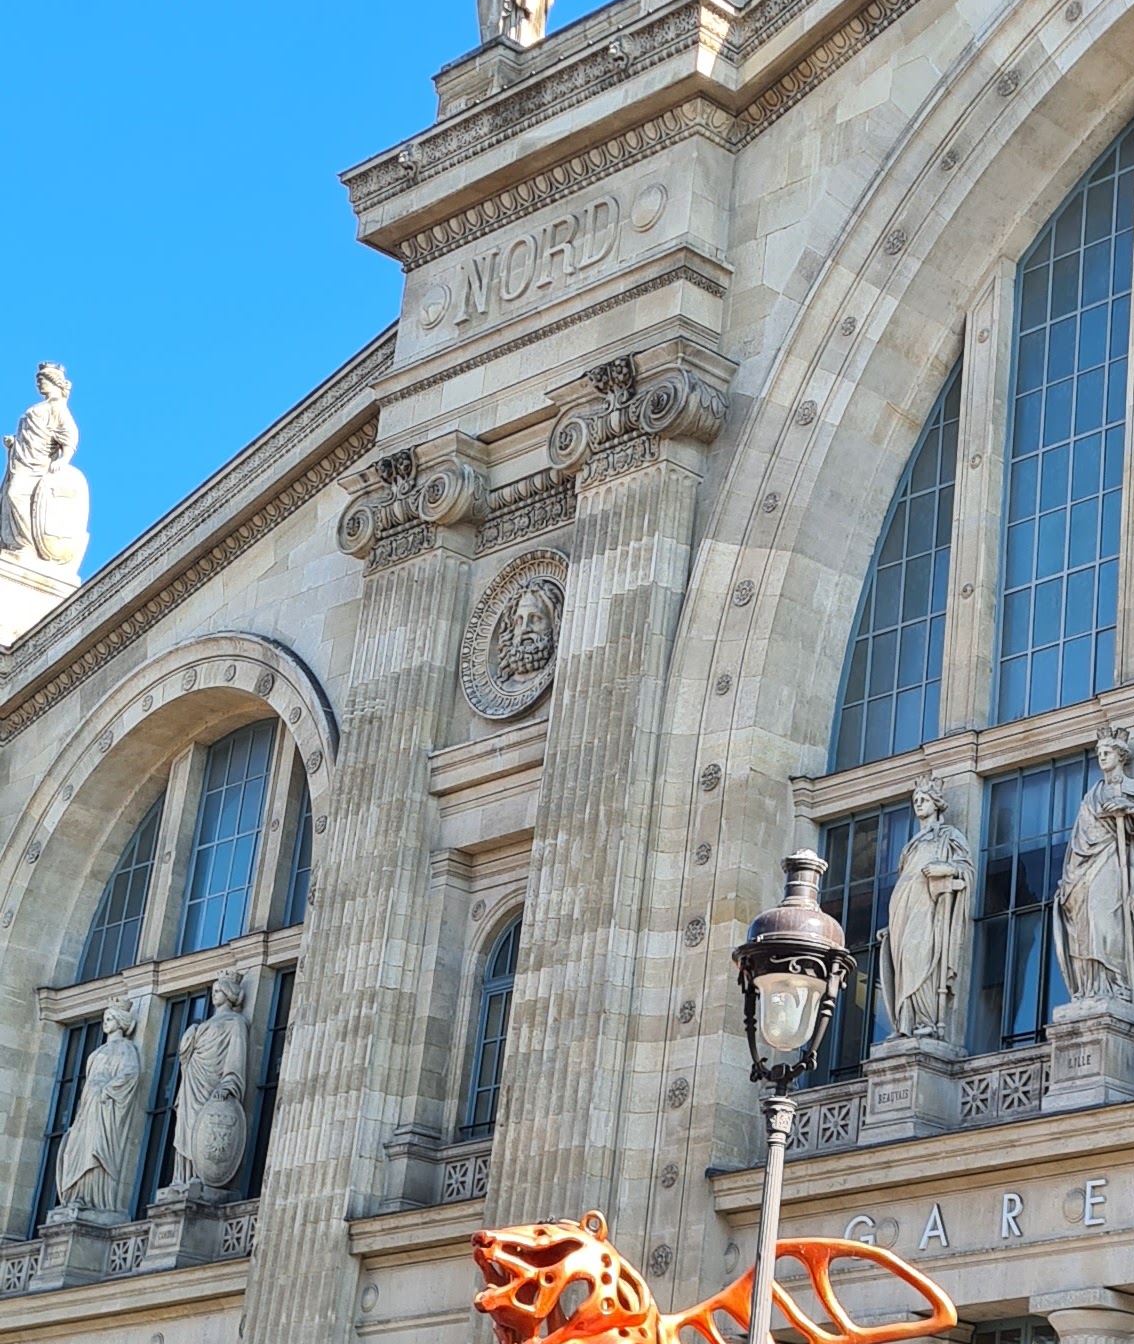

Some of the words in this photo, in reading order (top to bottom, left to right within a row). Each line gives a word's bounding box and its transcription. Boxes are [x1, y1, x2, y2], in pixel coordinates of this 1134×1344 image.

[454, 196, 620, 326] NORD
[1068, 1054, 1091, 1069] LILLE
[843, 1178, 1107, 1259] GARE
